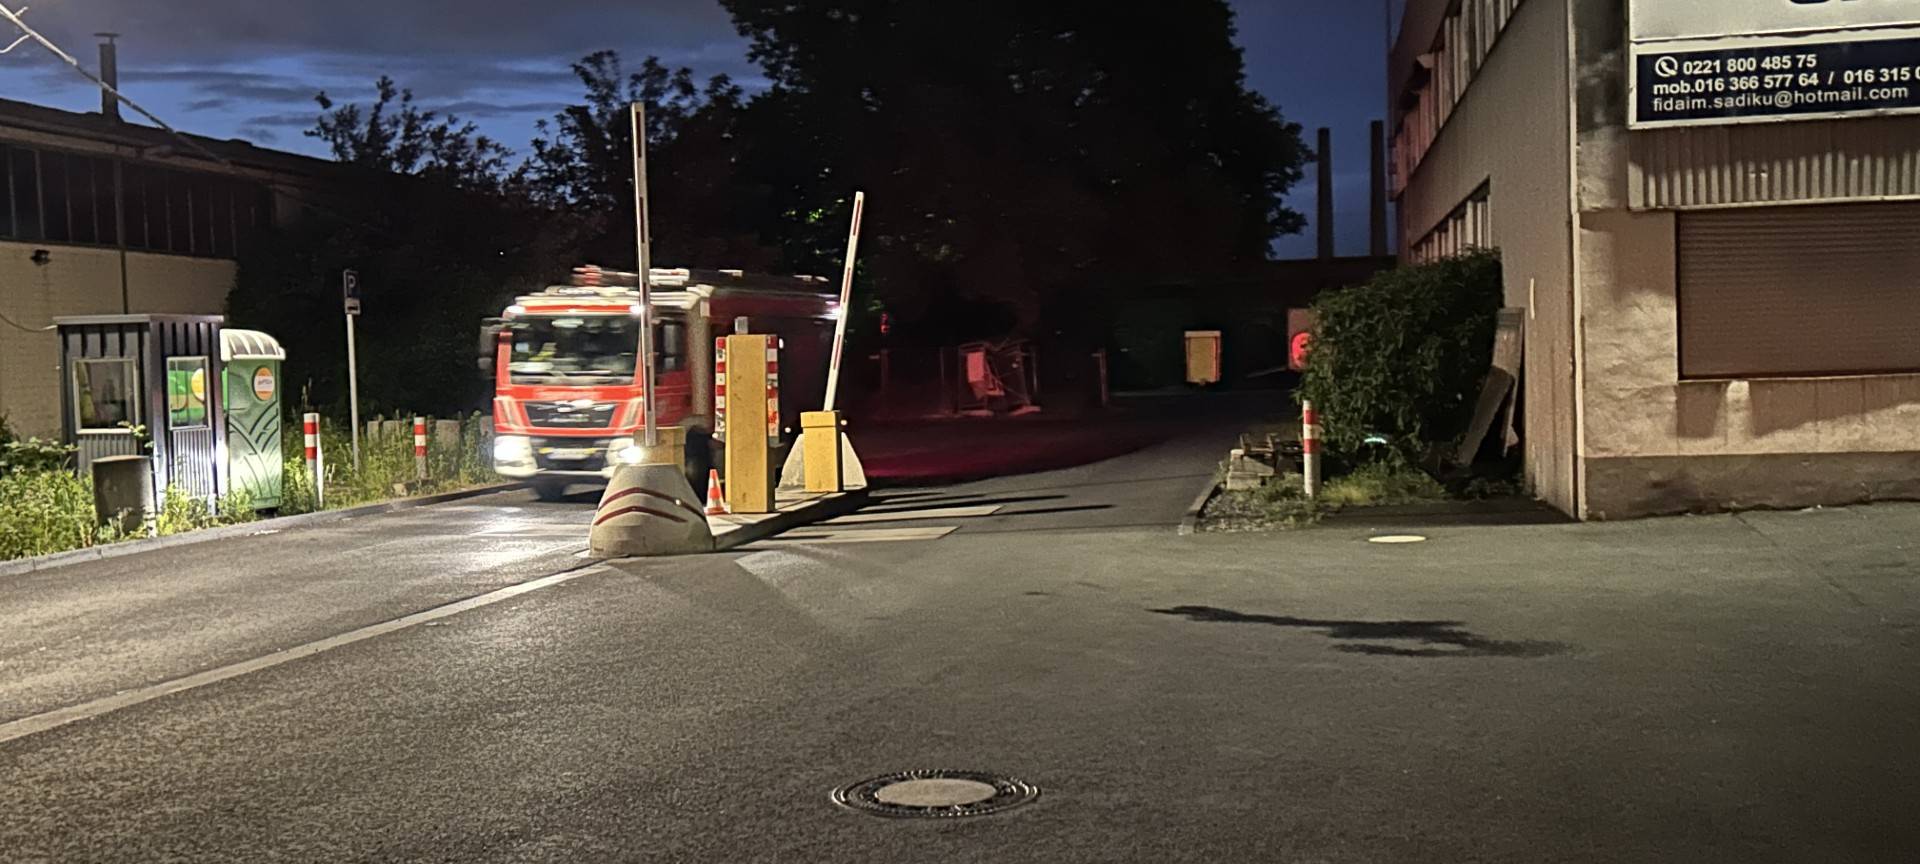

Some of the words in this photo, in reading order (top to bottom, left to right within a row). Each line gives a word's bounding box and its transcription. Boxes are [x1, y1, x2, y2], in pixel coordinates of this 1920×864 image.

[1683, 59, 1721, 75] 0221
[1727, 57, 1756, 72] 800
[1761, 55, 1792, 70] 485
[1796, 54, 1817, 68] 75
[1653, 78, 1725, 95] mob.016
[1729, 75, 1759, 91] 366
[1763, 73, 1794, 89] 577
[1798, 72, 1819, 87] 64
[1843, 69, 1875, 84] 016
[1879, 66, 1911, 82] 315
[1653, 87, 1908, 112] fidaim.sadiku@hotmail.com
[348, 275, 356, 294] P
